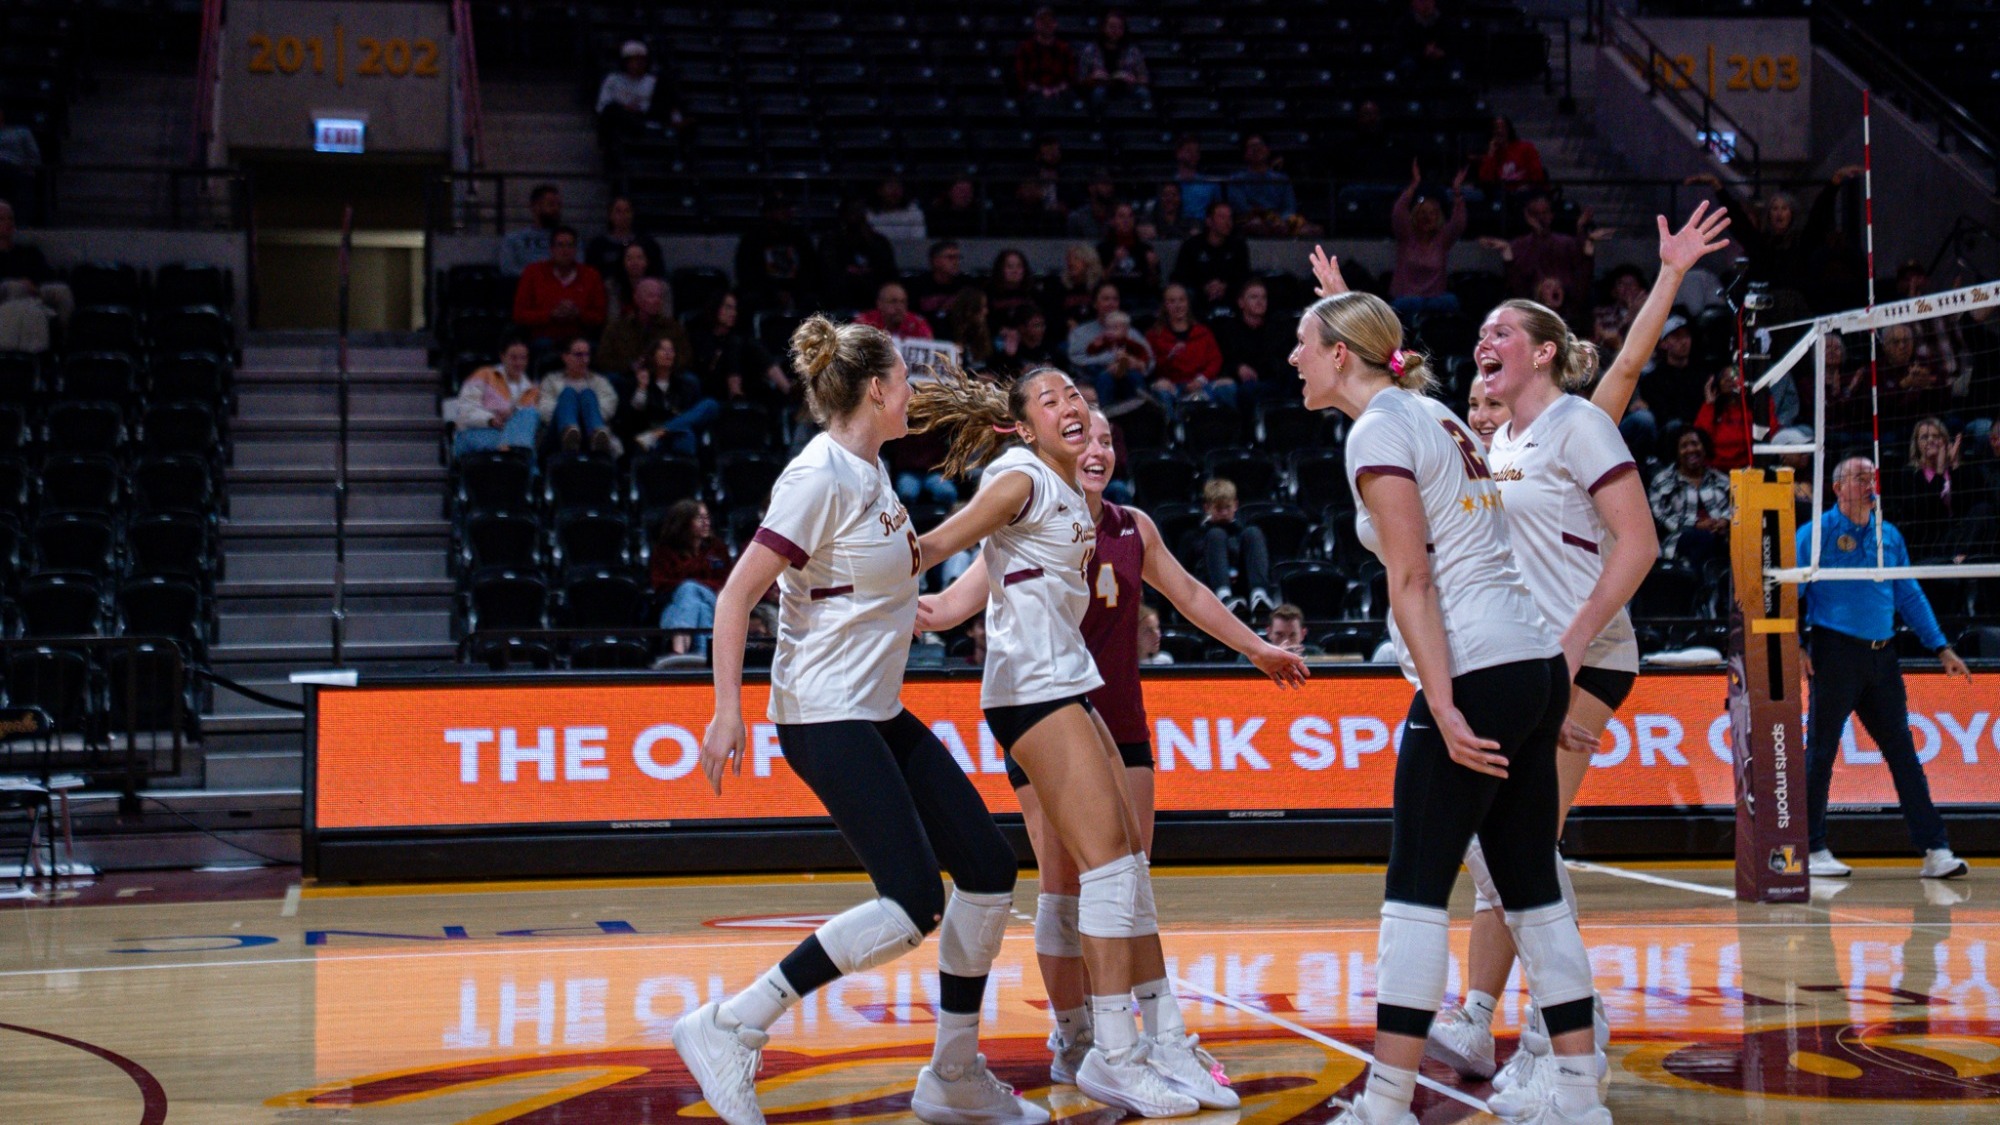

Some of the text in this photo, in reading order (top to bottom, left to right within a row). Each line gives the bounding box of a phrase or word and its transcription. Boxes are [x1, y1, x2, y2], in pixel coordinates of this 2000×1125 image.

[248, 34, 440, 76] 201 202
[1726, 54, 1800, 91] 203
[907, 530, 921, 578] 6
[1095, 562, 1119, 608] 4
[444, 726, 610, 784] THE
[1154, 715, 1271, 772] NK
[1842, 710, 2000, 766] LOY
[1771, 723, 1789, 829] sports imports
